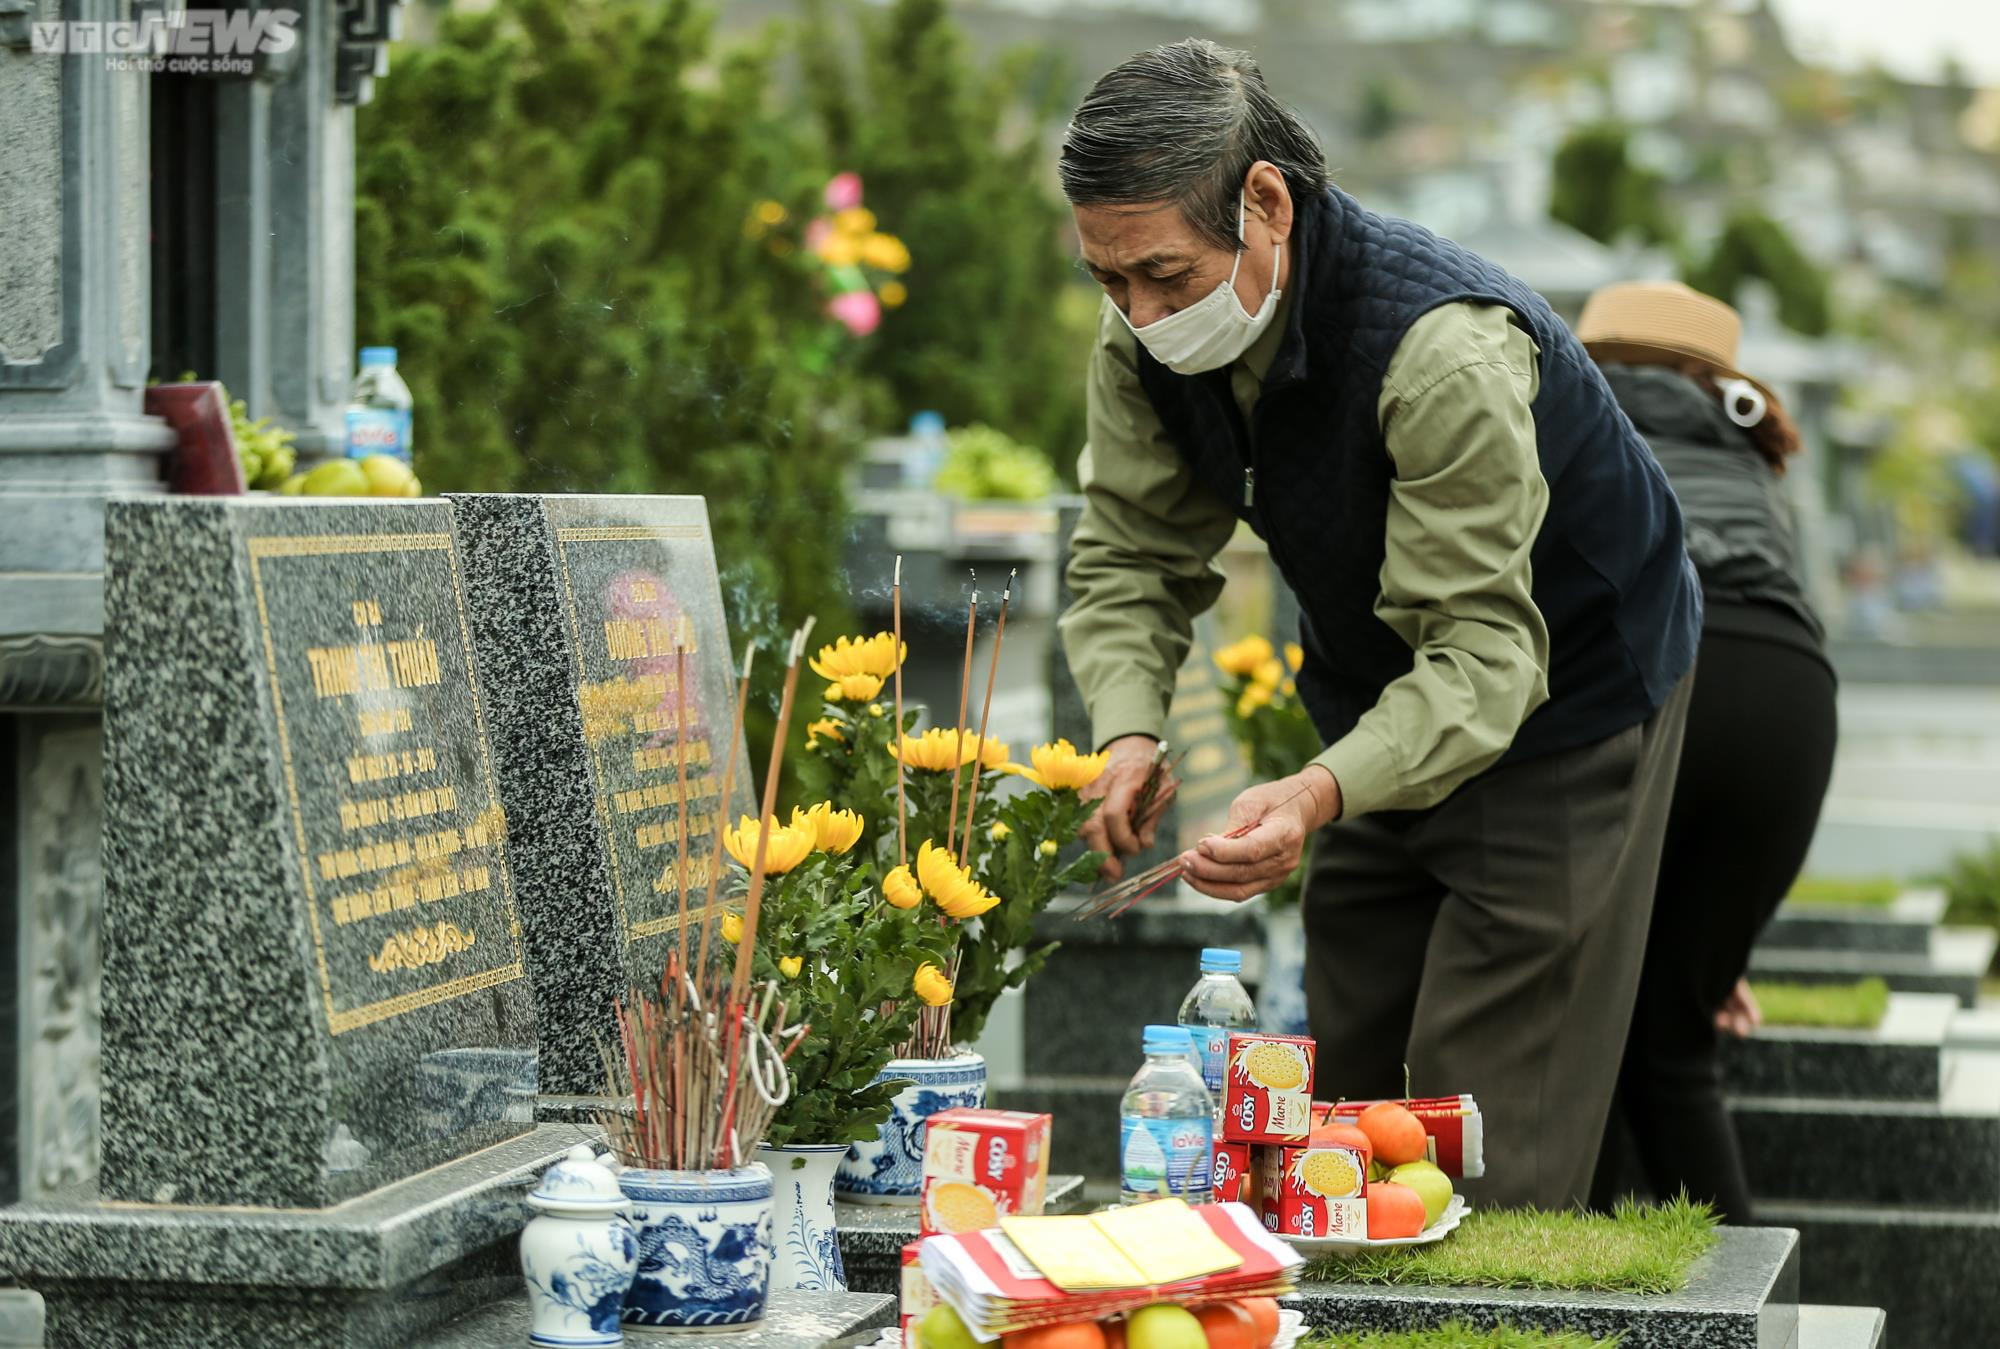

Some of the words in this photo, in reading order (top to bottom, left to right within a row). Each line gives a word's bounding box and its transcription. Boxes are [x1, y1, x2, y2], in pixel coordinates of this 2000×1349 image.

[1240, 1091, 1256, 1132] COSY
[1271, 1095, 1286, 1130] Marie
[987, 1136, 1009, 1182] COSY
[1212, 1151, 1231, 1192] COSY
[1330, 1202, 1344, 1237] Marie
